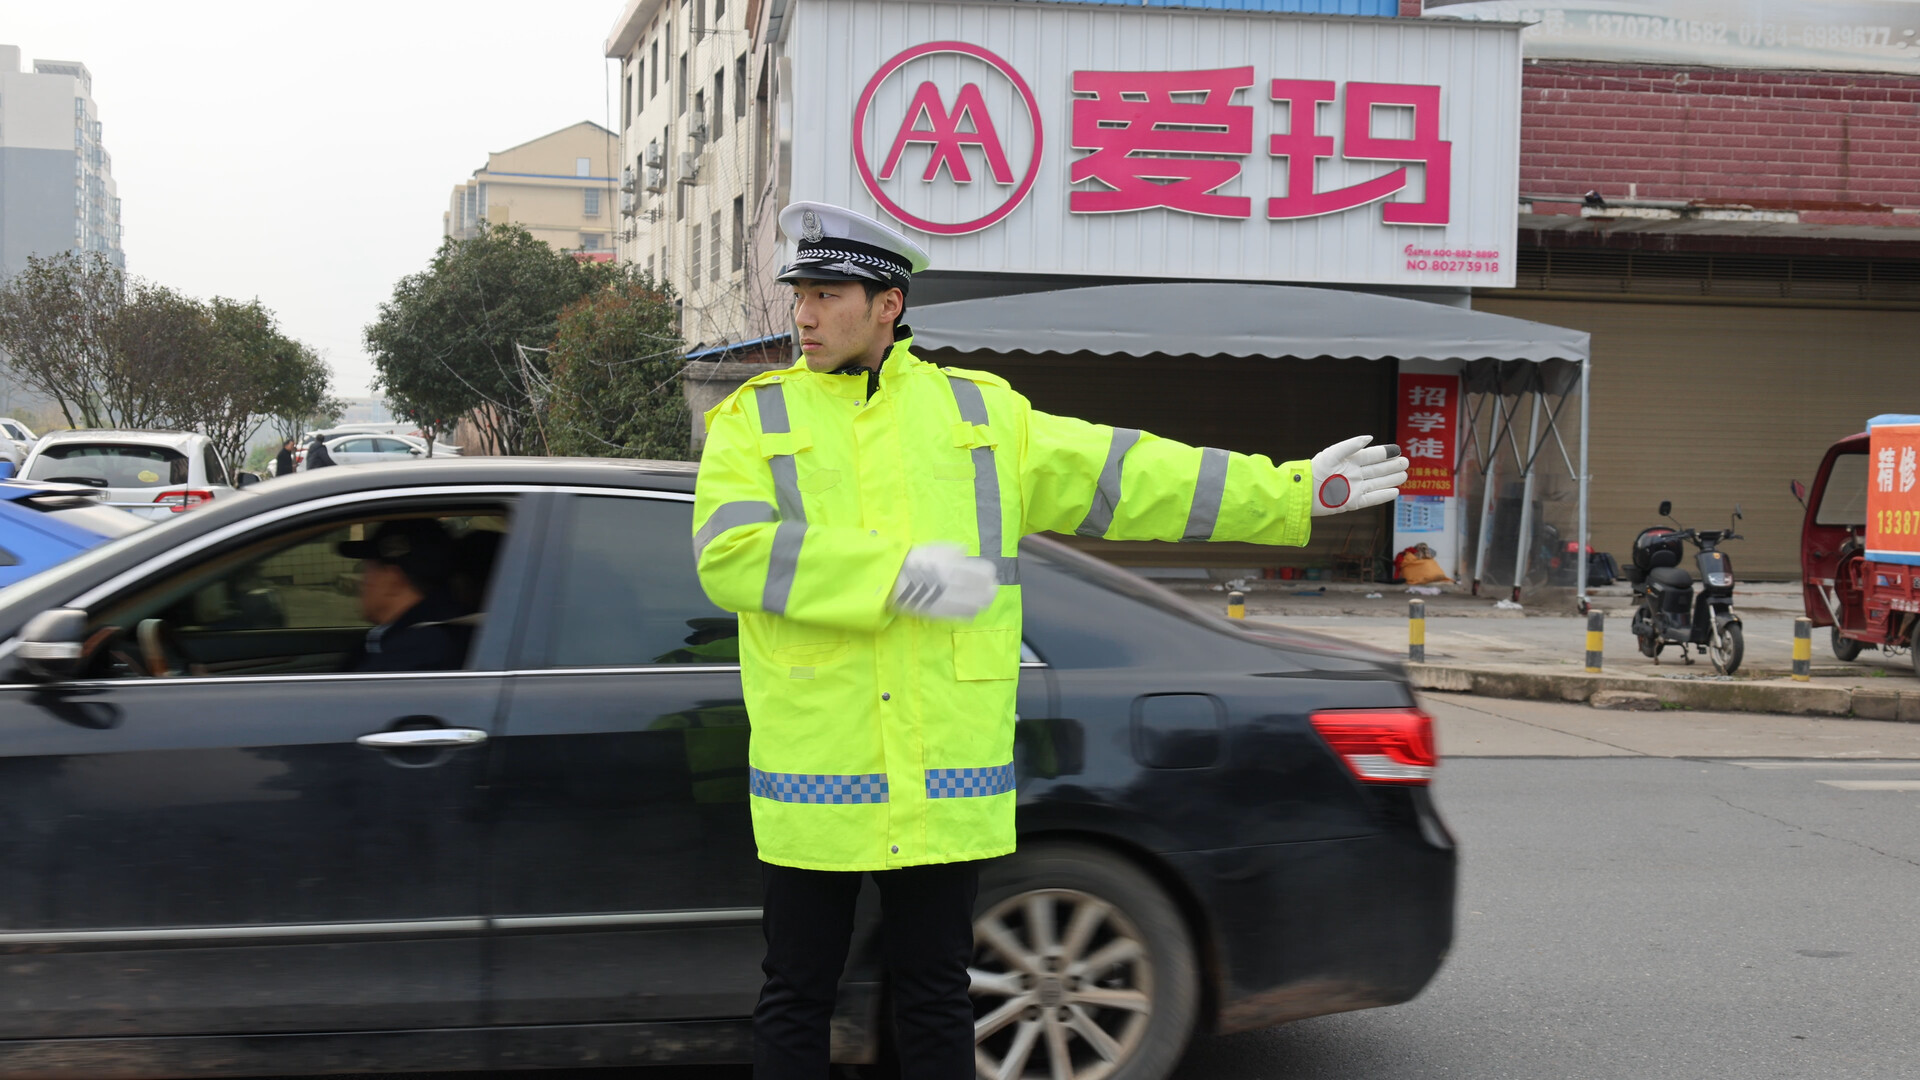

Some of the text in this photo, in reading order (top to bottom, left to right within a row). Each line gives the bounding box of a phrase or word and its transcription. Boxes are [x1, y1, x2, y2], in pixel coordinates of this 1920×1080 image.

[1588, 14, 1728, 44] 13707341582
[1738, 23, 1891, 48] 0734-6989677
[1070, 66, 1452, 226] 爱玛
[1407, 260, 1499, 273] NO.80273918
[1406, 385, 1447, 459] 招学徒
[1877, 446, 1917, 493] 精修
